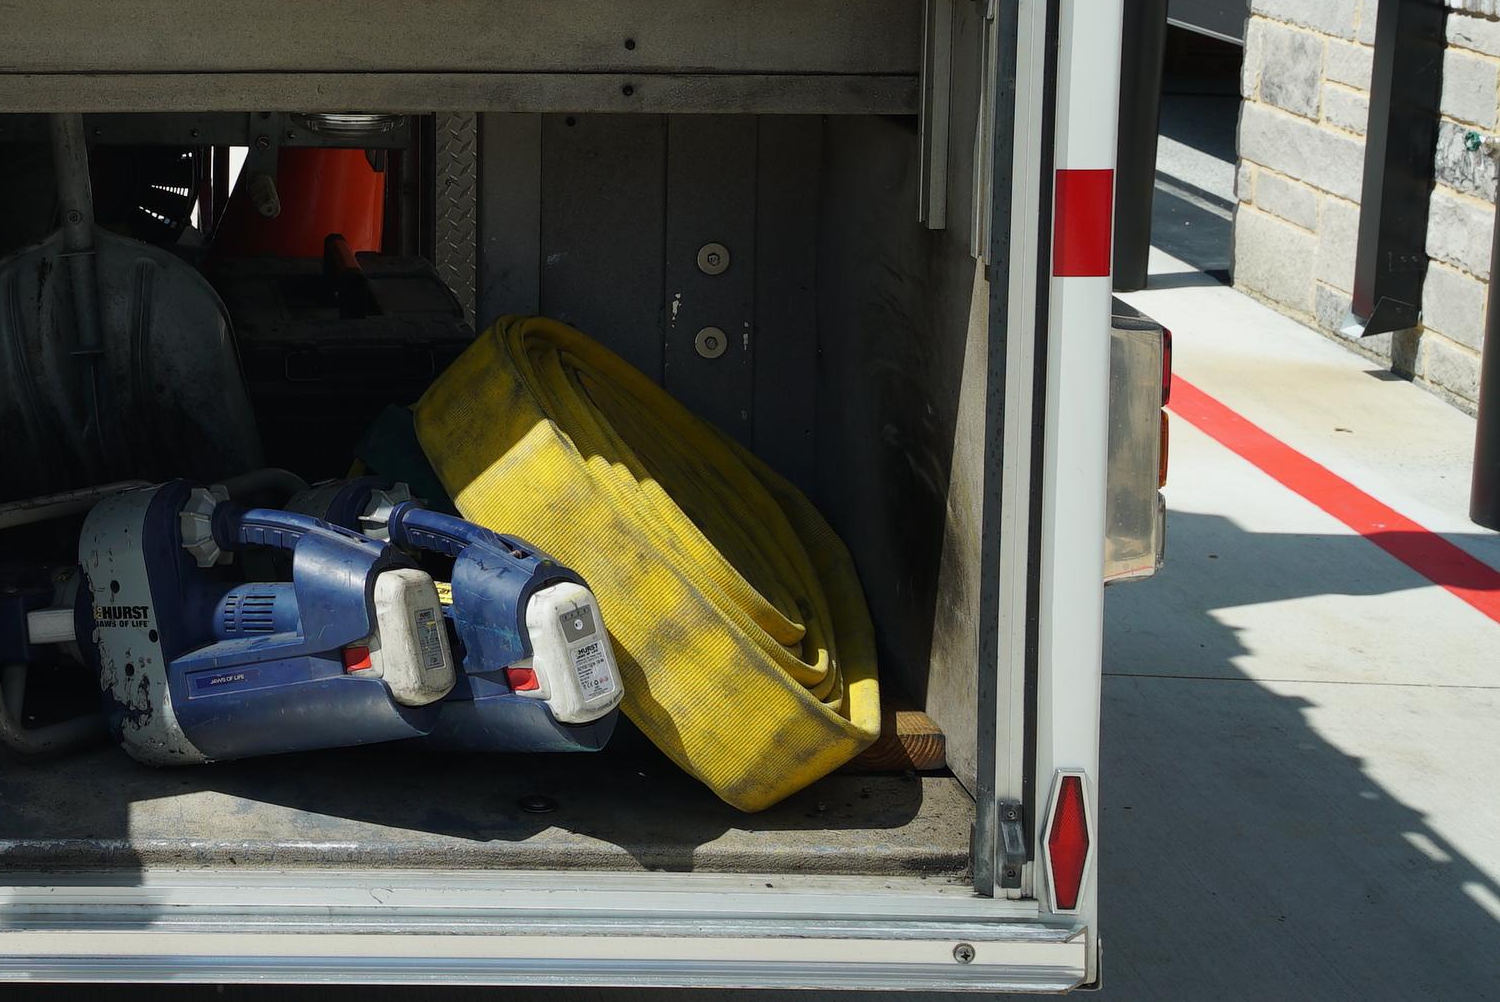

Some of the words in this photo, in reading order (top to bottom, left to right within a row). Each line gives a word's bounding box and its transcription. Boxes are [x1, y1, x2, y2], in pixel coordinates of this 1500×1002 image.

[102, 606, 149, 620] HURST
[119, 620, 129, 628] OF
[131, 620, 149, 628] LIFE
[578, 643, 598, 655] HURST
